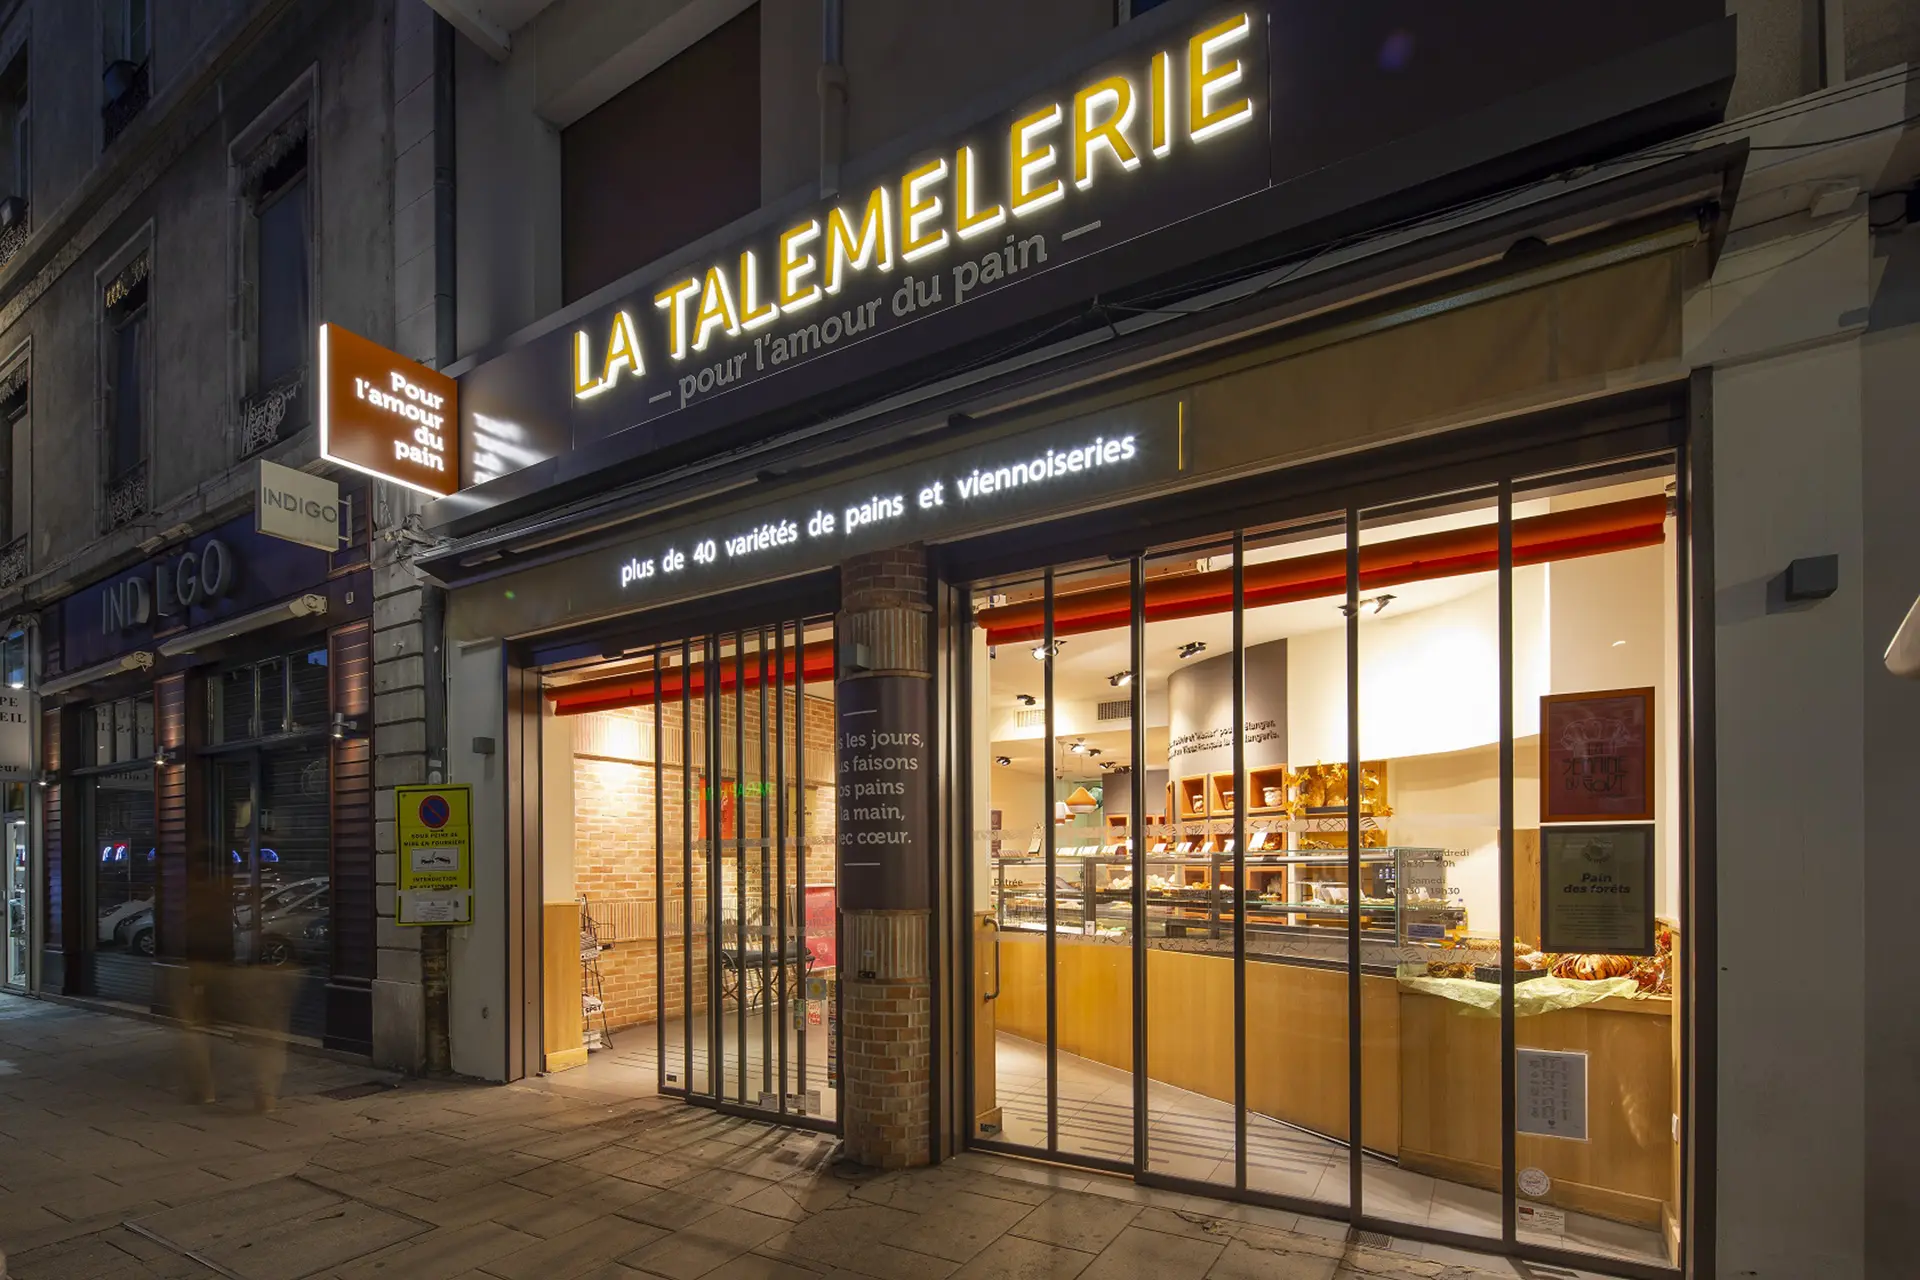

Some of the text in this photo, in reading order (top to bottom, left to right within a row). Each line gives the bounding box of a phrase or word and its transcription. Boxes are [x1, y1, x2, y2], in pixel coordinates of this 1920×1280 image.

[573, 11, 1255, 401] LA TALEMELERIE
[678, 231, 1048, 408] pour l'amour du pain
[355, 376, 445, 430] l'amour
[390, 371, 445, 410] Pour
[413, 425, 445, 452] du
[393, 440, 445, 472] pain
[262, 485, 338, 525] INDIGO
[621, 432, 1136, 587] plus de 40 variétés de pains et viennoiseries
[101, 538, 231, 636] INDIGO
[846, 732, 867, 749] les
[871, 730, 924, 750] jours,
[852, 756, 918, 772] faisons
[854, 780, 905, 800] pains
[853, 804, 905, 821] main,
[857, 831, 912, 845] cœur.
[1563, 884, 1587, 894] des
[1581, 872, 1612, 883] Pain
